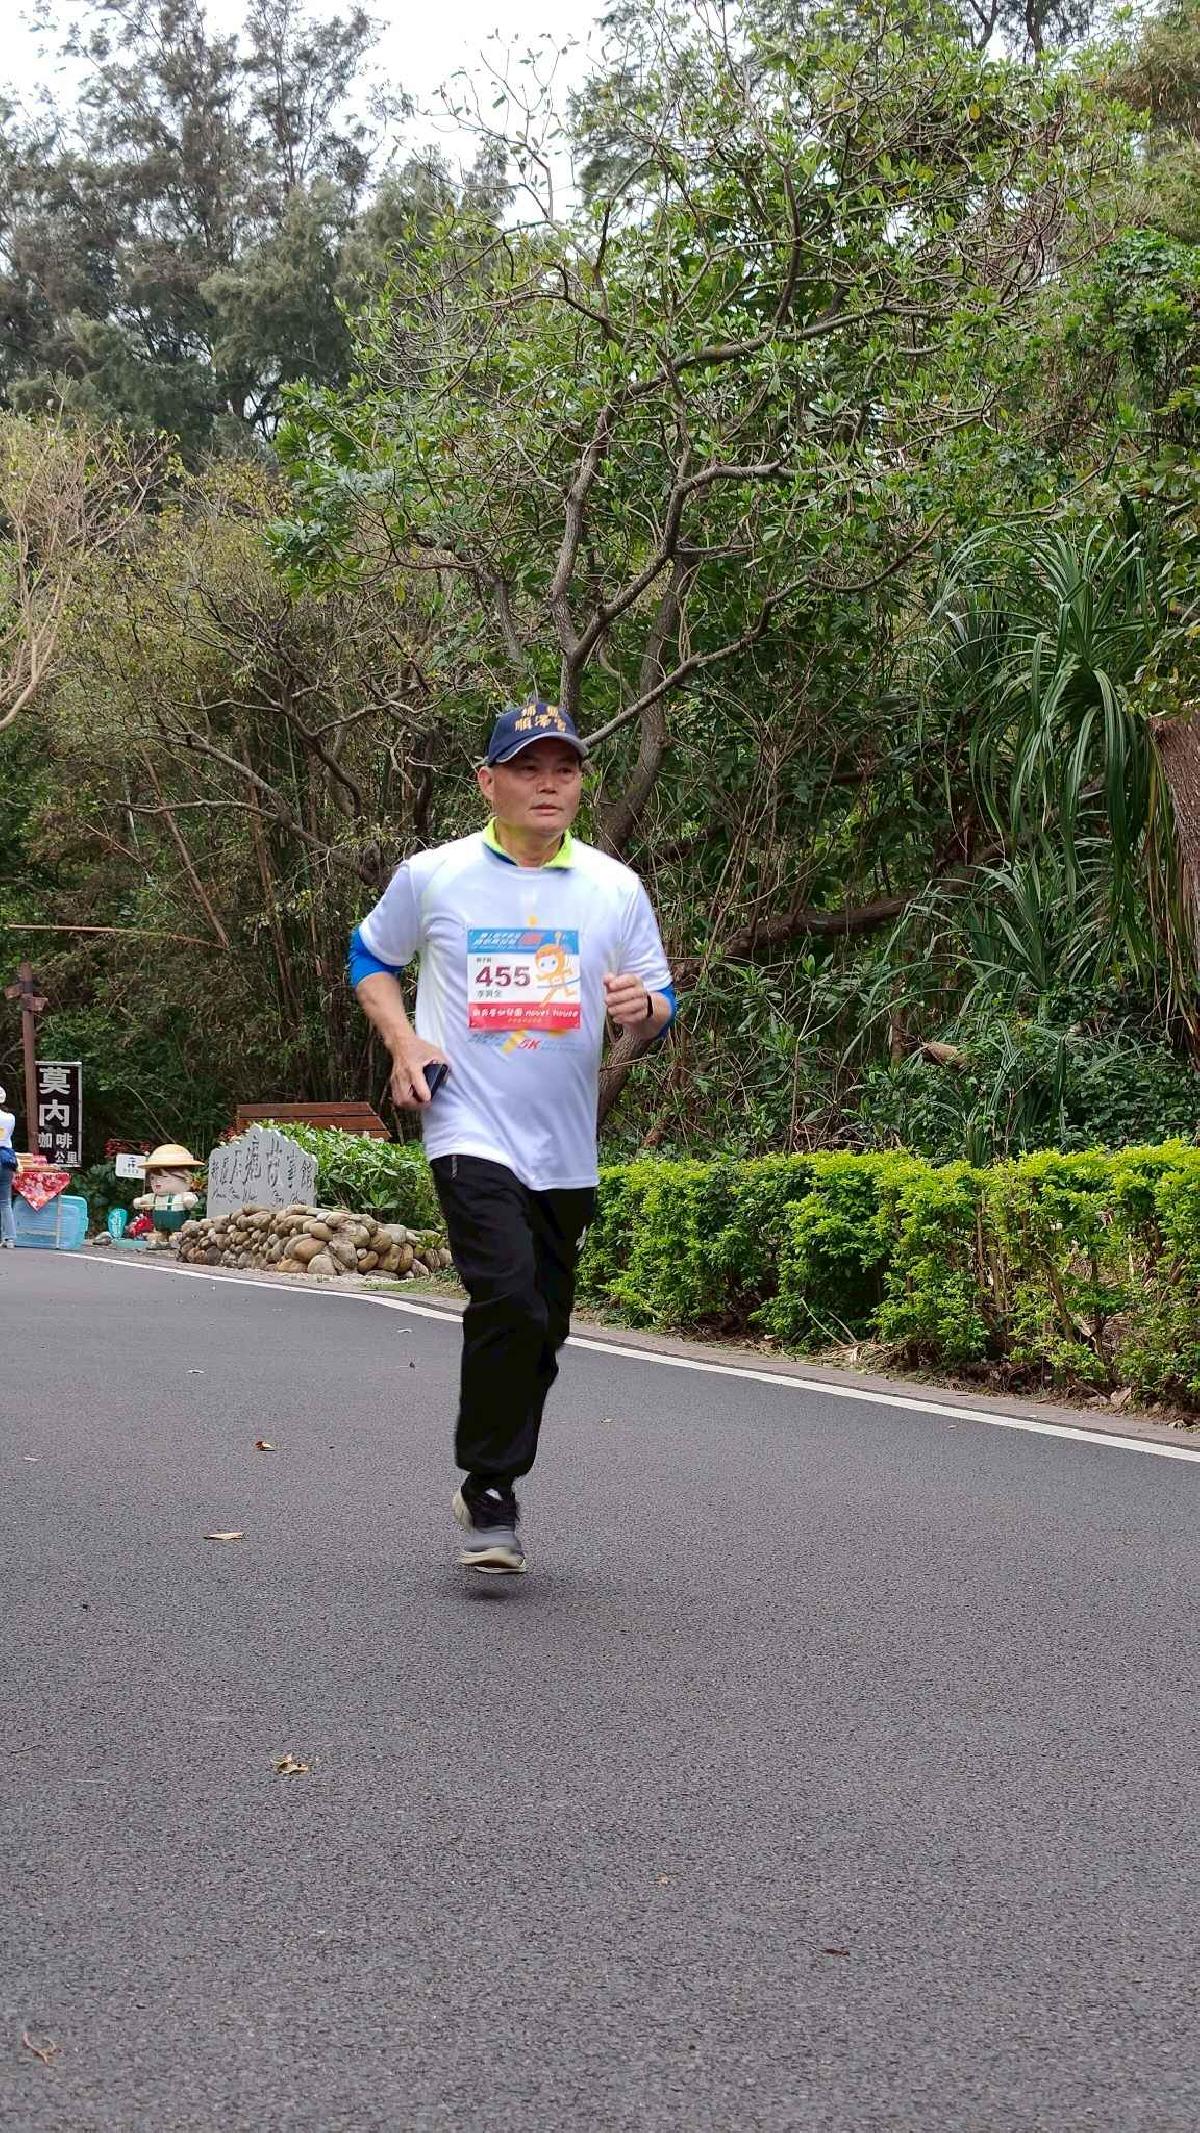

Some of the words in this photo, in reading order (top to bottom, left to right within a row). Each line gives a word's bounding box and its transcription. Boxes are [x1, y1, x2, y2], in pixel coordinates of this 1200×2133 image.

[475, 966, 531, 987] 455
[38, 1066, 71, 1127] 莫內
[37, 1131, 73, 1149] 咖啡
